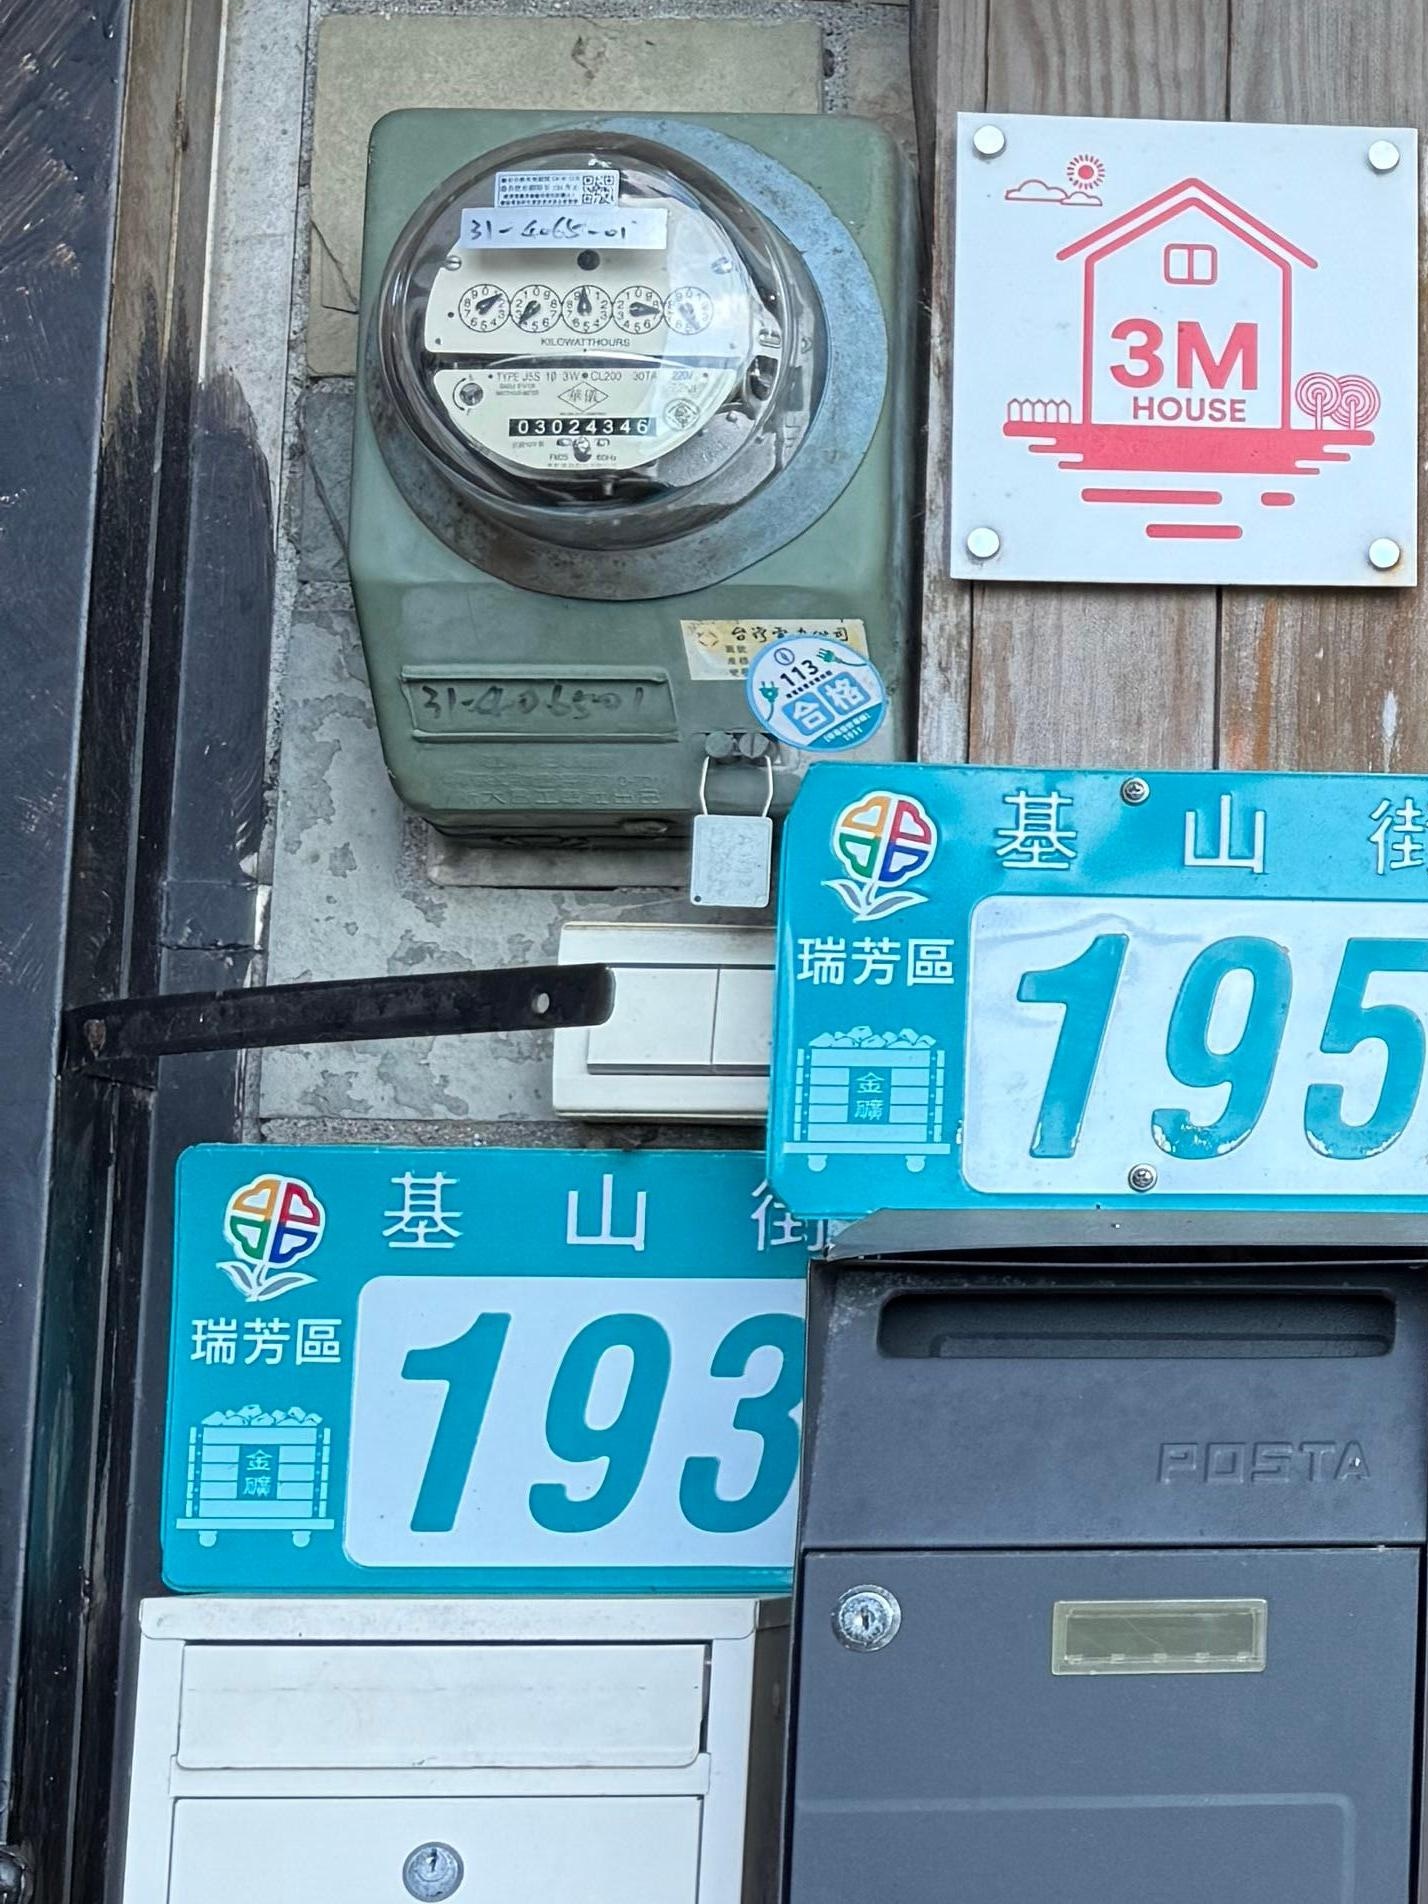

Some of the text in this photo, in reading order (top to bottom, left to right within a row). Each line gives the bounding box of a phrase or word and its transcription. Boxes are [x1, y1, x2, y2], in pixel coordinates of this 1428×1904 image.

[541, 338, 631, 348] KILOWATTHOURS
[1109, 317, 1259, 391] 3M
[517, 419, 650, 435] 03024346
[1131, 395, 1247, 424] HOUSE
[779, 659, 820, 688] 113
[792, 678, 866, 730] 合格
[796, 936, 956, 987] 瑞芳區
[854, 1071, 886, 1121] 金礦
[189, 1317, 342, 1367] 瑞芳區
[400, 1310, 806, 1534] 193
[242, 1446, 272, 1500] 金礦
[1157, 1439, 1373, 1484] POSTA
